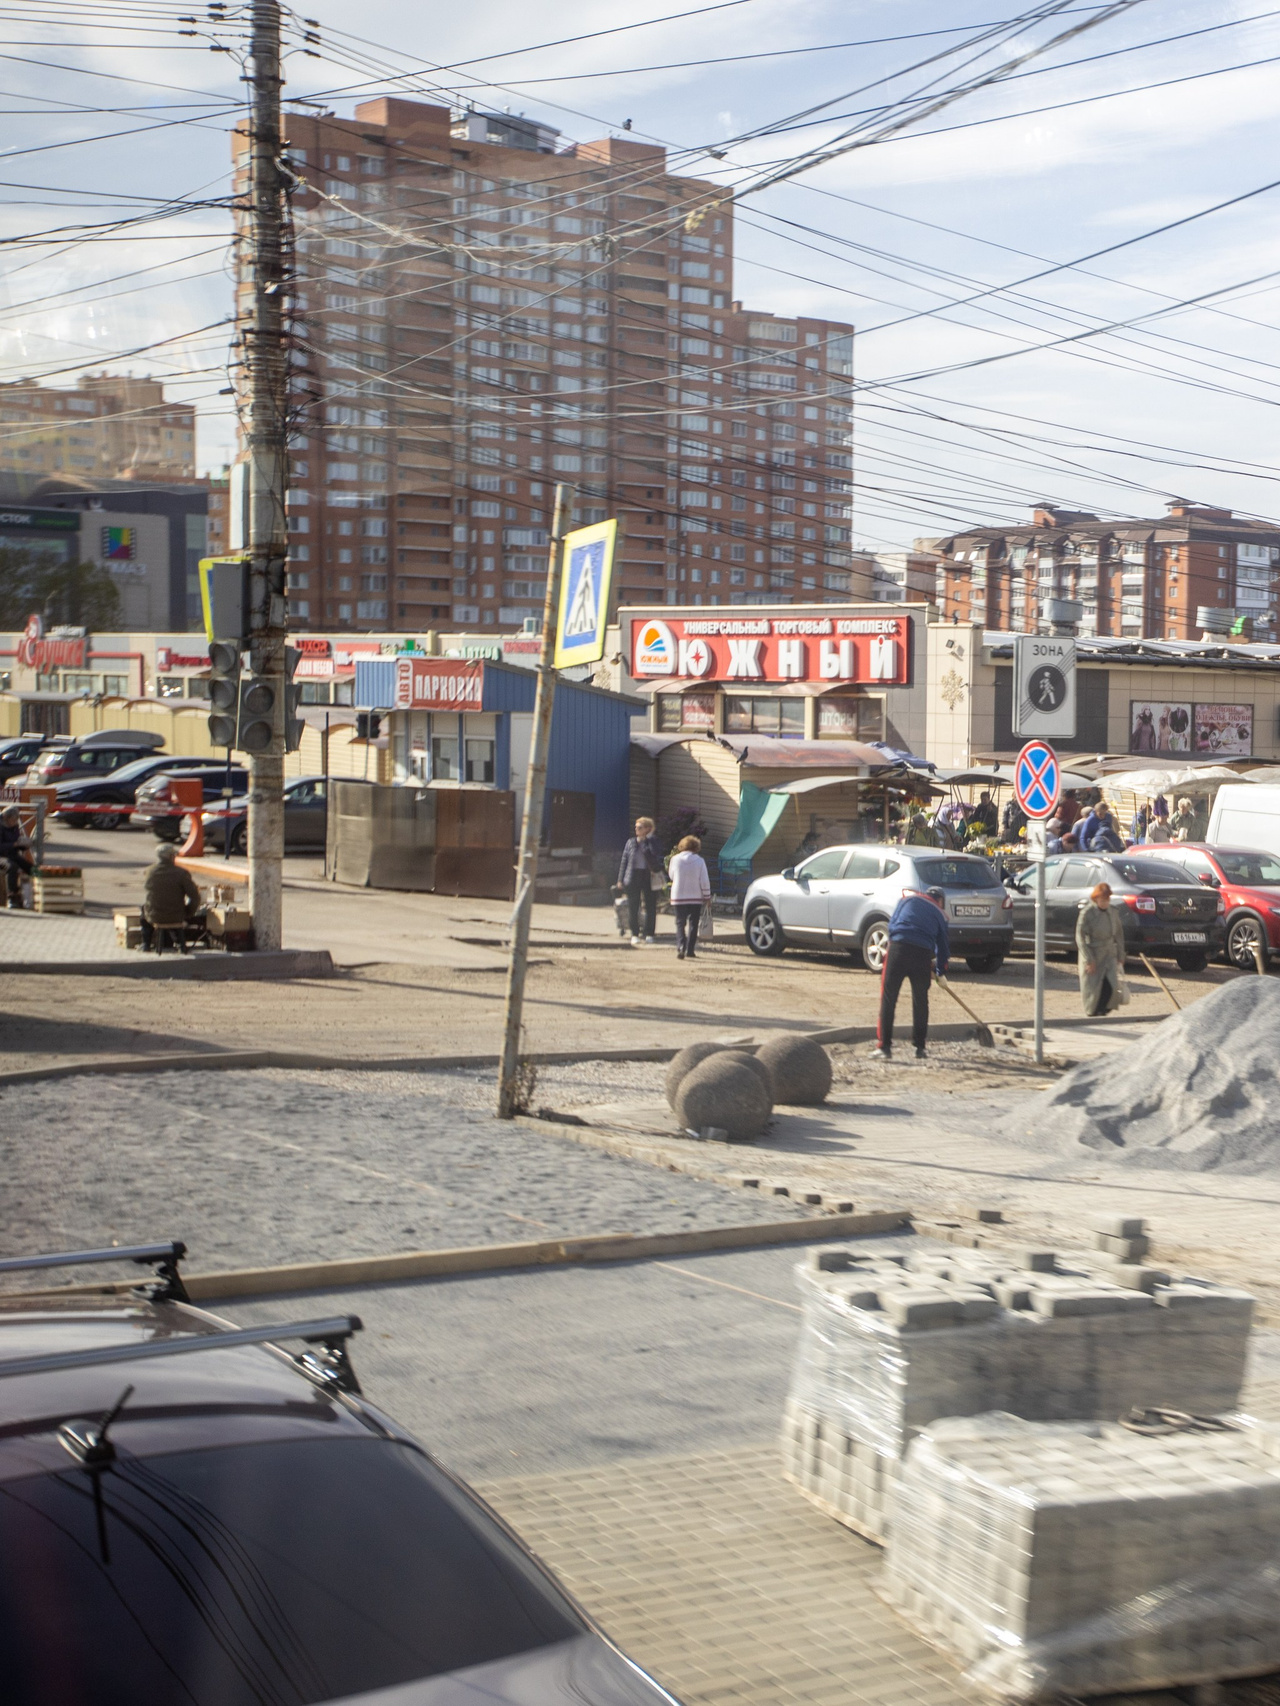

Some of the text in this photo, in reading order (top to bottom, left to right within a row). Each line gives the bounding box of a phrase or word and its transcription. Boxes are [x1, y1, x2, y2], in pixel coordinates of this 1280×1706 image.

[683, 618, 897, 635] УНИВЕРСАЛЬНЫЙ ТОРГОВЫЙ КОМПЛЕКС
[678, 635, 898, 679] ЮЖНЫЙ
[1032, 644, 1064, 657] ЗОНА
[415, 674, 482, 702] ПАРКОВКА
